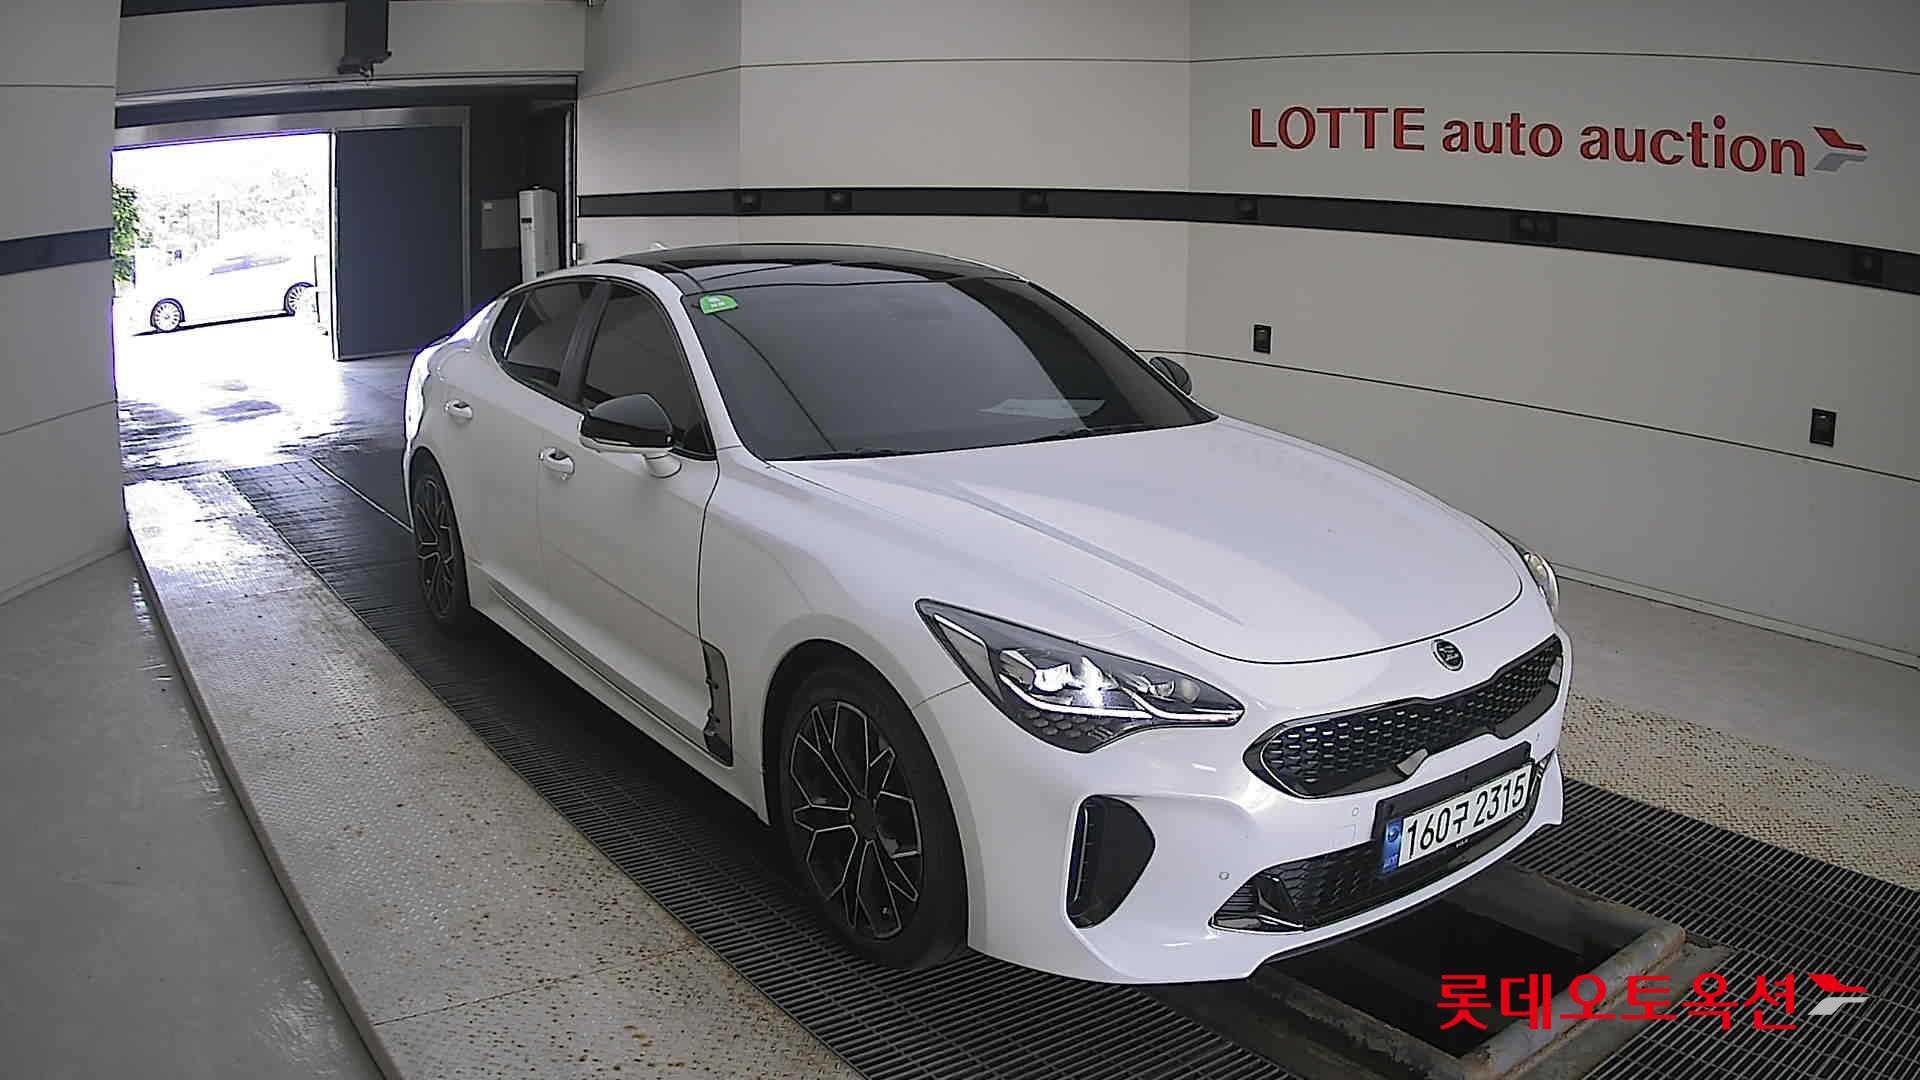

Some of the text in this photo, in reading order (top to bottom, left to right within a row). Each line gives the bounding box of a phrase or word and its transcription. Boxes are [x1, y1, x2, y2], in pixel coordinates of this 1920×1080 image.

[1251, 106, 1806, 177] LOTTE auto auction
[1407, 772, 1527, 860] 160구 2315
